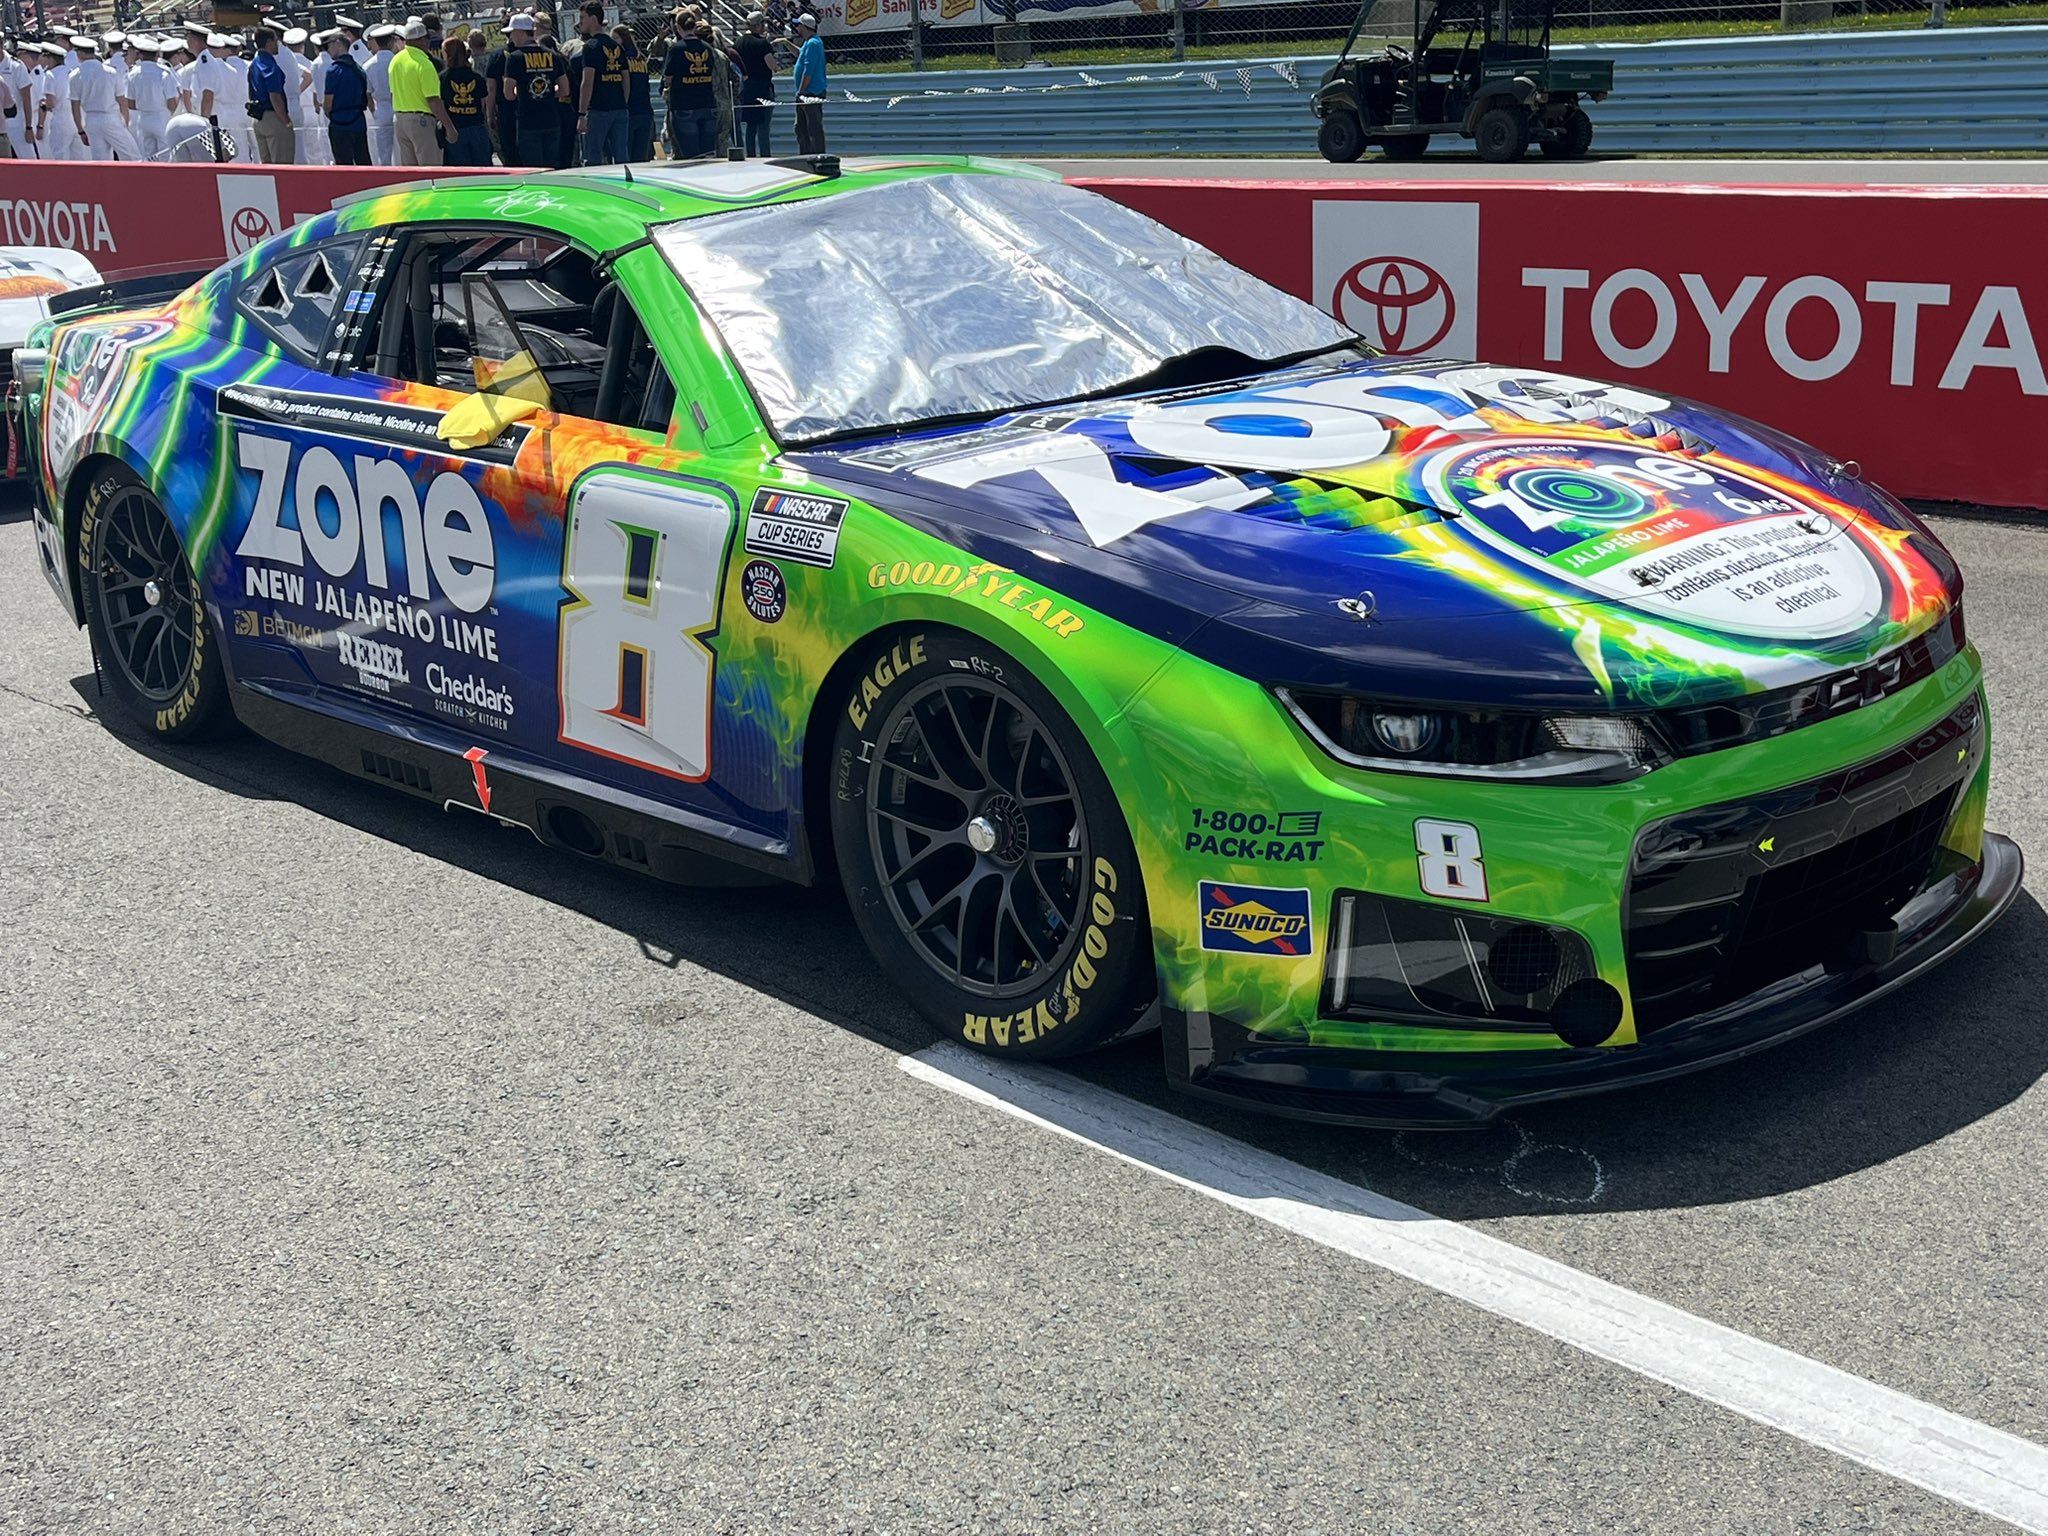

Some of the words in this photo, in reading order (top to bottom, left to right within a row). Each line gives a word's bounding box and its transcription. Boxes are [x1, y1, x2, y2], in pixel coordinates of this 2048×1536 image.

[524, 52, 554, 69] NAVY
[1485, 68, 1516, 77] Kawasaki
[0, 198, 118, 253] TOYOTA
[1522, 267, 2048, 398] TOYOTA
[224, 388, 271, 409] WARNING:
[268, 399, 289, 413] This
[285, 403, 321, 415] product
[319, 406, 352, 421] contains
[350, 410, 383, 426] nicotine.
[383, 415, 417, 433] Nicotine
[416, 421, 425, 432] is
[425, 424, 438, 435] an
[778, 496, 834, 522] NASCAR
[1467, 456, 1715, 533] zone
[1712, 490, 1763, 515] 6
[1755, 499, 1792, 512] MG
[79, 482, 102, 571] EAGLE
[235, 432, 495, 614] zone
[758, 522, 784, 542] CUP
[781, 527, 825, 550] SERIES
[1563, 529, 1649, 569] JALAPEÑO
[1648, 517, 1690, 538] LIME
[1648, 541, 1732, 581] WARNING:
[1718, 530, 1757, 551] This
[1753, 520, 1806, 548] product
[1663, 567, 1731, 604] contains
[1724, 550, 1785, 578] nicotine.
[1777, 538, 1839, 559] Nicotine
[747, 566, 780, 588] NASCAR
[754, 585, 775, 599] 250
[1726, 586, 1748, 603] is
[1749, 579, 1774, 597] an
[1771, 561, 1831, 589] addictive
[1774, 581, 1842, 615] chemical
[245, 566, 305, 606] NEW
[315, 581, 435, 643] JALAPEÑO
[440, 615, 499, 663] LIME
[558, 466, 736, 782] 8
[746, 595, 781, 618] SALUTES
[262, 616, 323, 648] BETMGM
[336, 630, 411, 684] REBEL
[358, 671, 391, 694] BOURBON
[425, 662, 515, 716] Cheddar's
[847, 633, 929, 733] EAGLE
[434, 698, 464, 718] SCRATCH
[478, 711, 508, 732] KITCHEN
[1185, 832, 1325, 862] PACK-RAT
[1412, 815, 1490, 902] 8
[1208, 910, 1302, 934] SUNOCO
[963, 855, 1118, 1046] GOODYEAR
